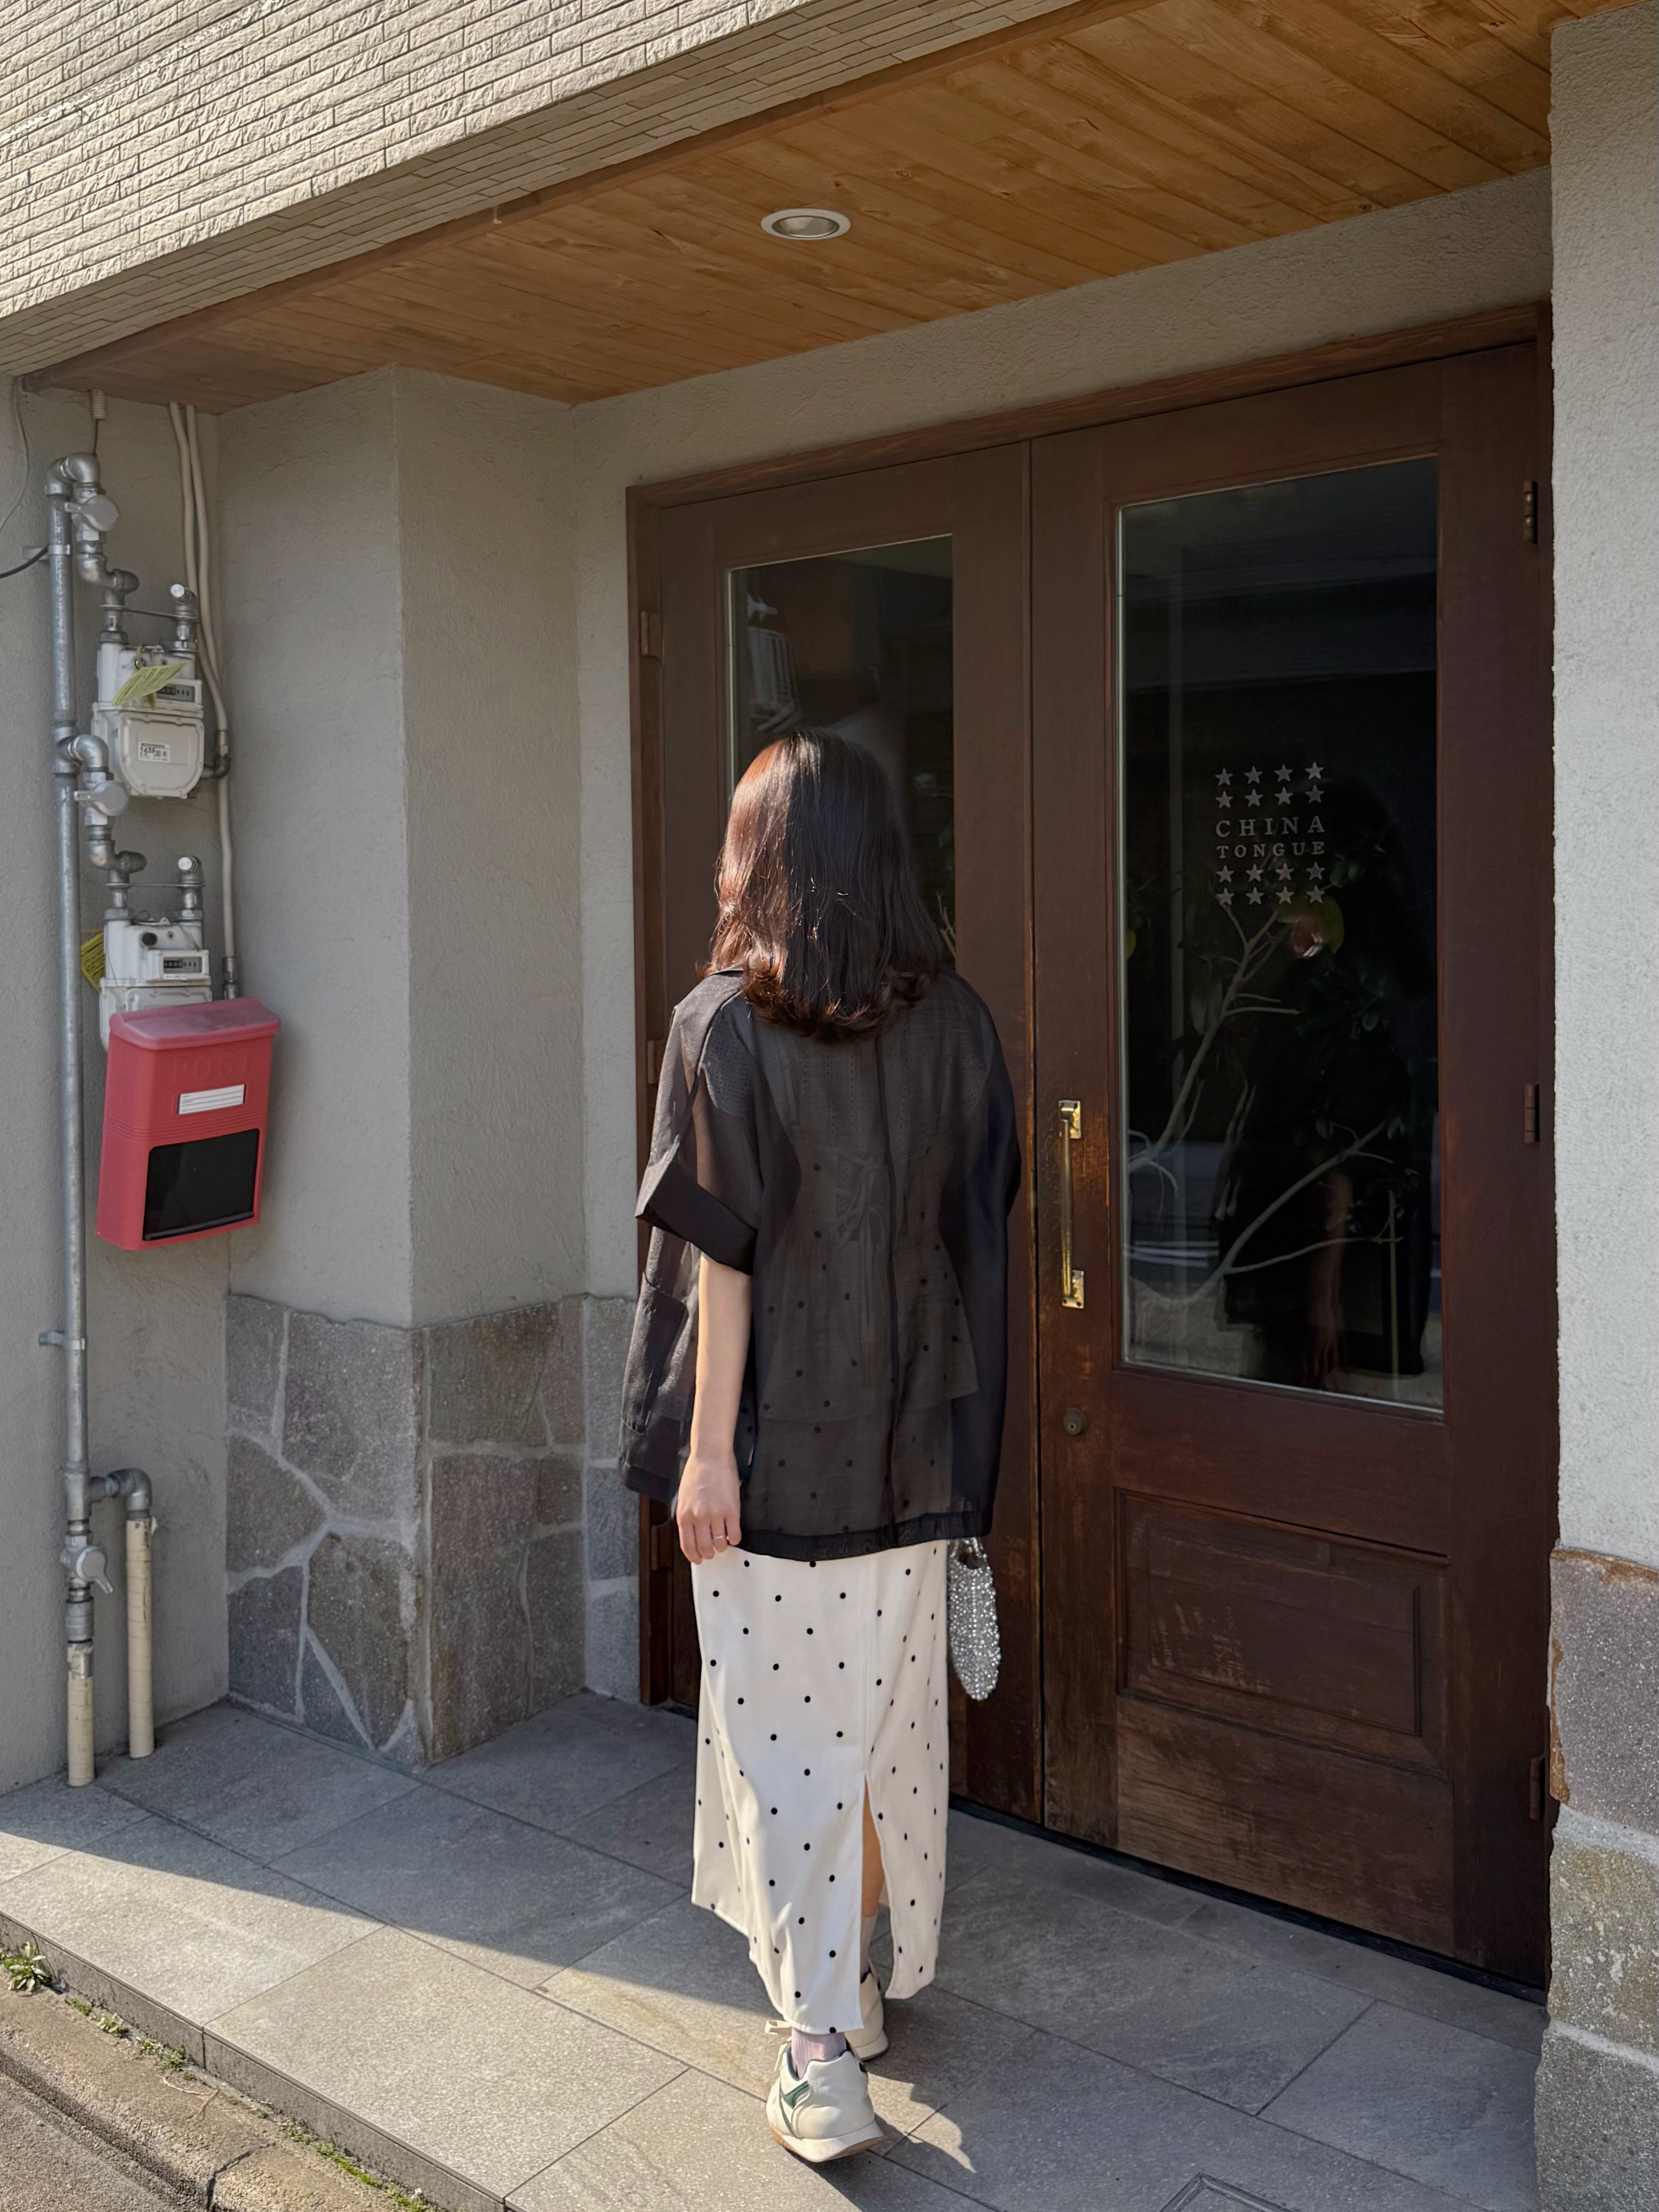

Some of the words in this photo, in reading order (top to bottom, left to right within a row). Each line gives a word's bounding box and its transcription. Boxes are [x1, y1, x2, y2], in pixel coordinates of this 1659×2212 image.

[1216, 815, 1325, 837] CHINA
[1216, 841, 1325, 859] TONGUE
[173, 1048, 255, 1085] POST
